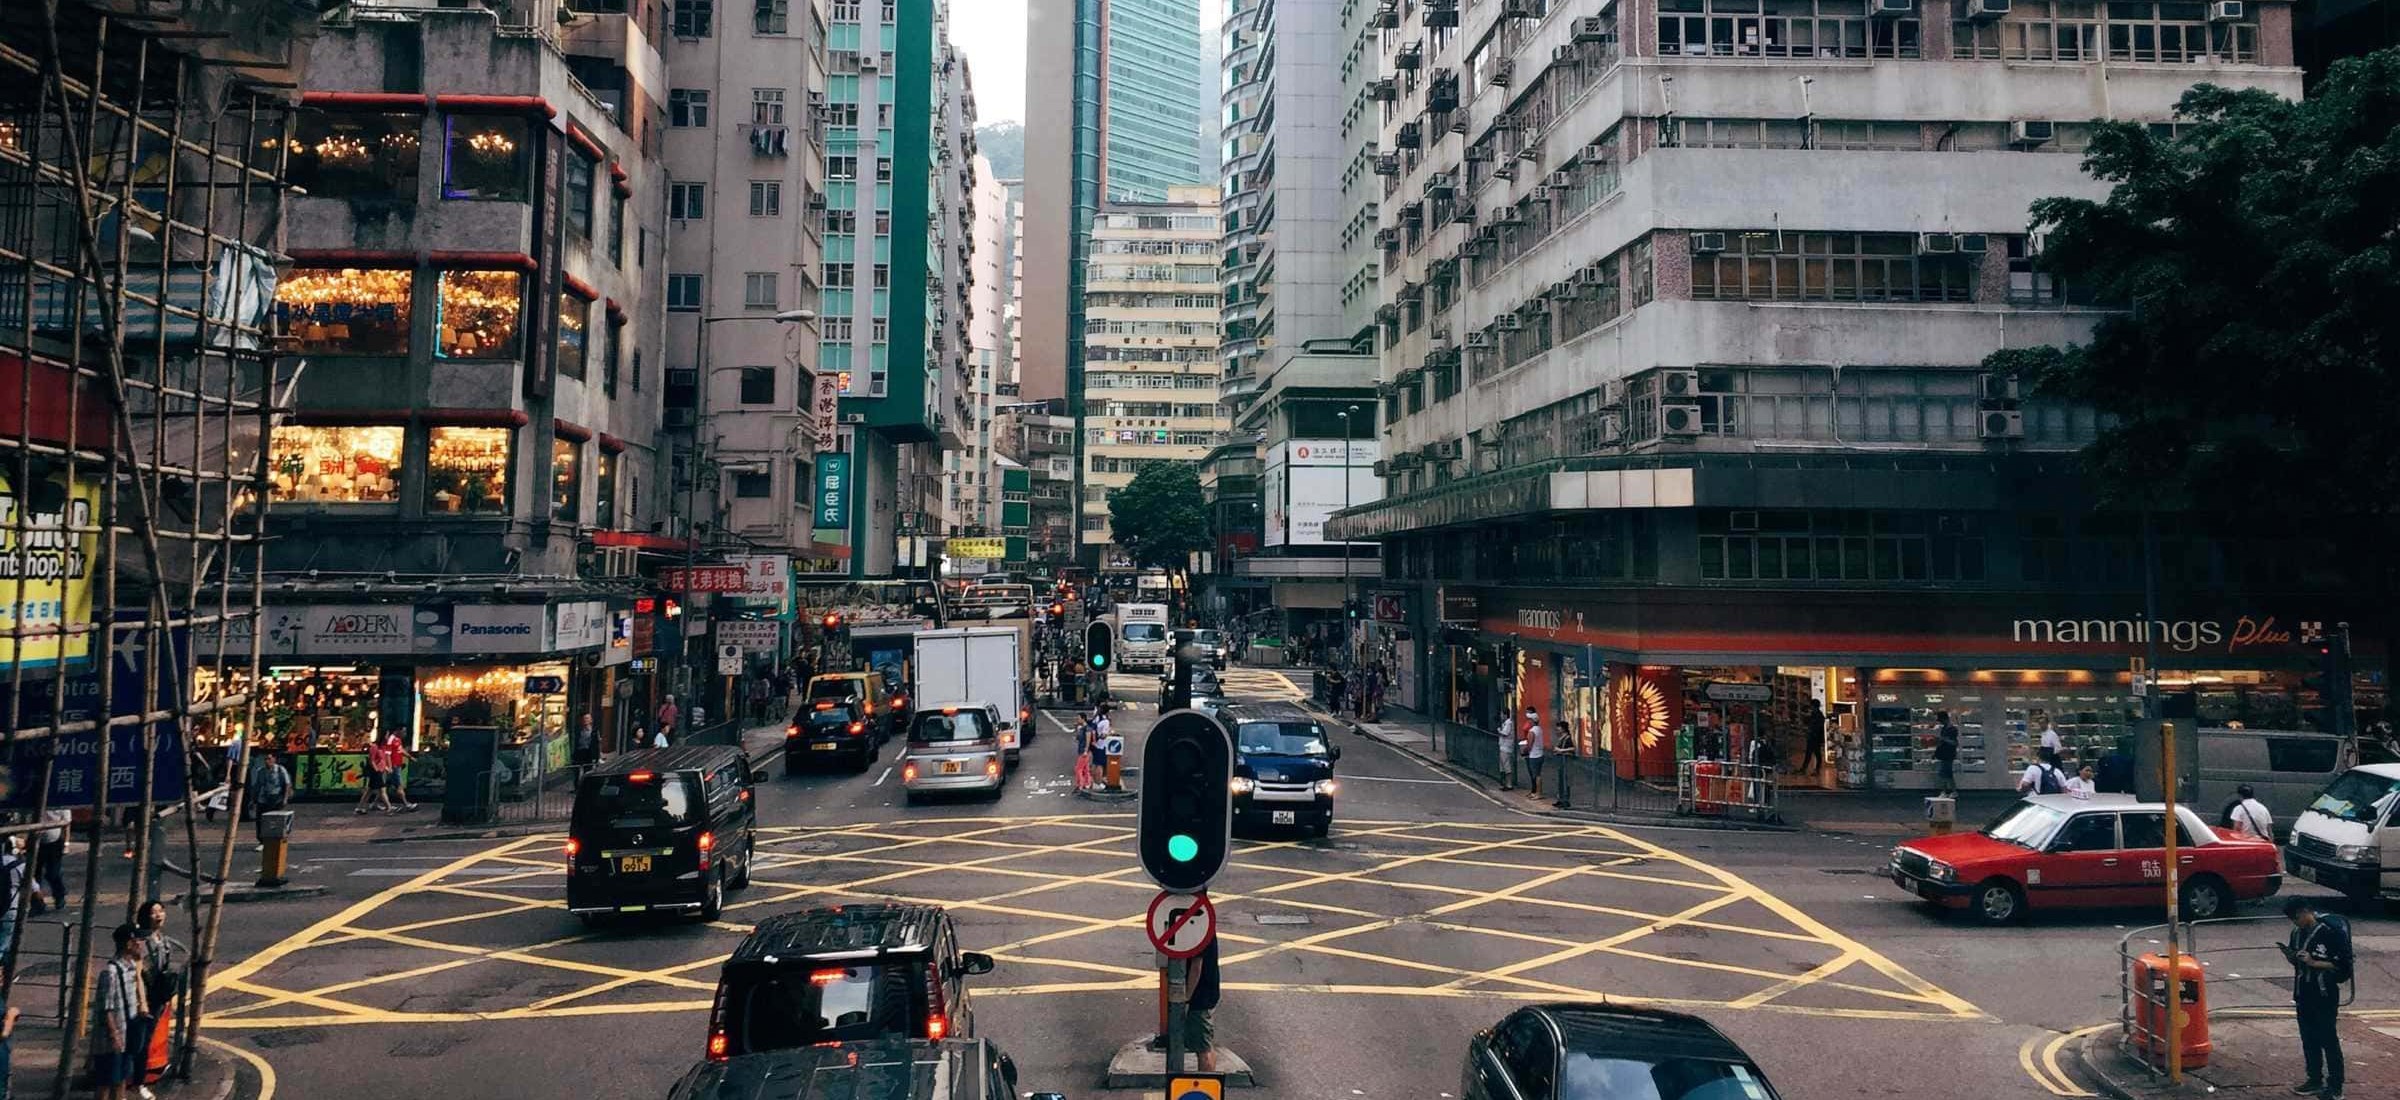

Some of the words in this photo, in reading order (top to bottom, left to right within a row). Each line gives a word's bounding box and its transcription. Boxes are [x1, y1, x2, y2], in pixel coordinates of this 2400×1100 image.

[824, 475, 840, 522] 屈臣氏
[461, 623, 530, 634] Panasonic
[1518, 604, 1560, 637] mannings
[2013, 612, 2221, 651] mannings
[2228, 615, 2290, 654] Plus
[2143, 868, 2162, 878] TAXI
